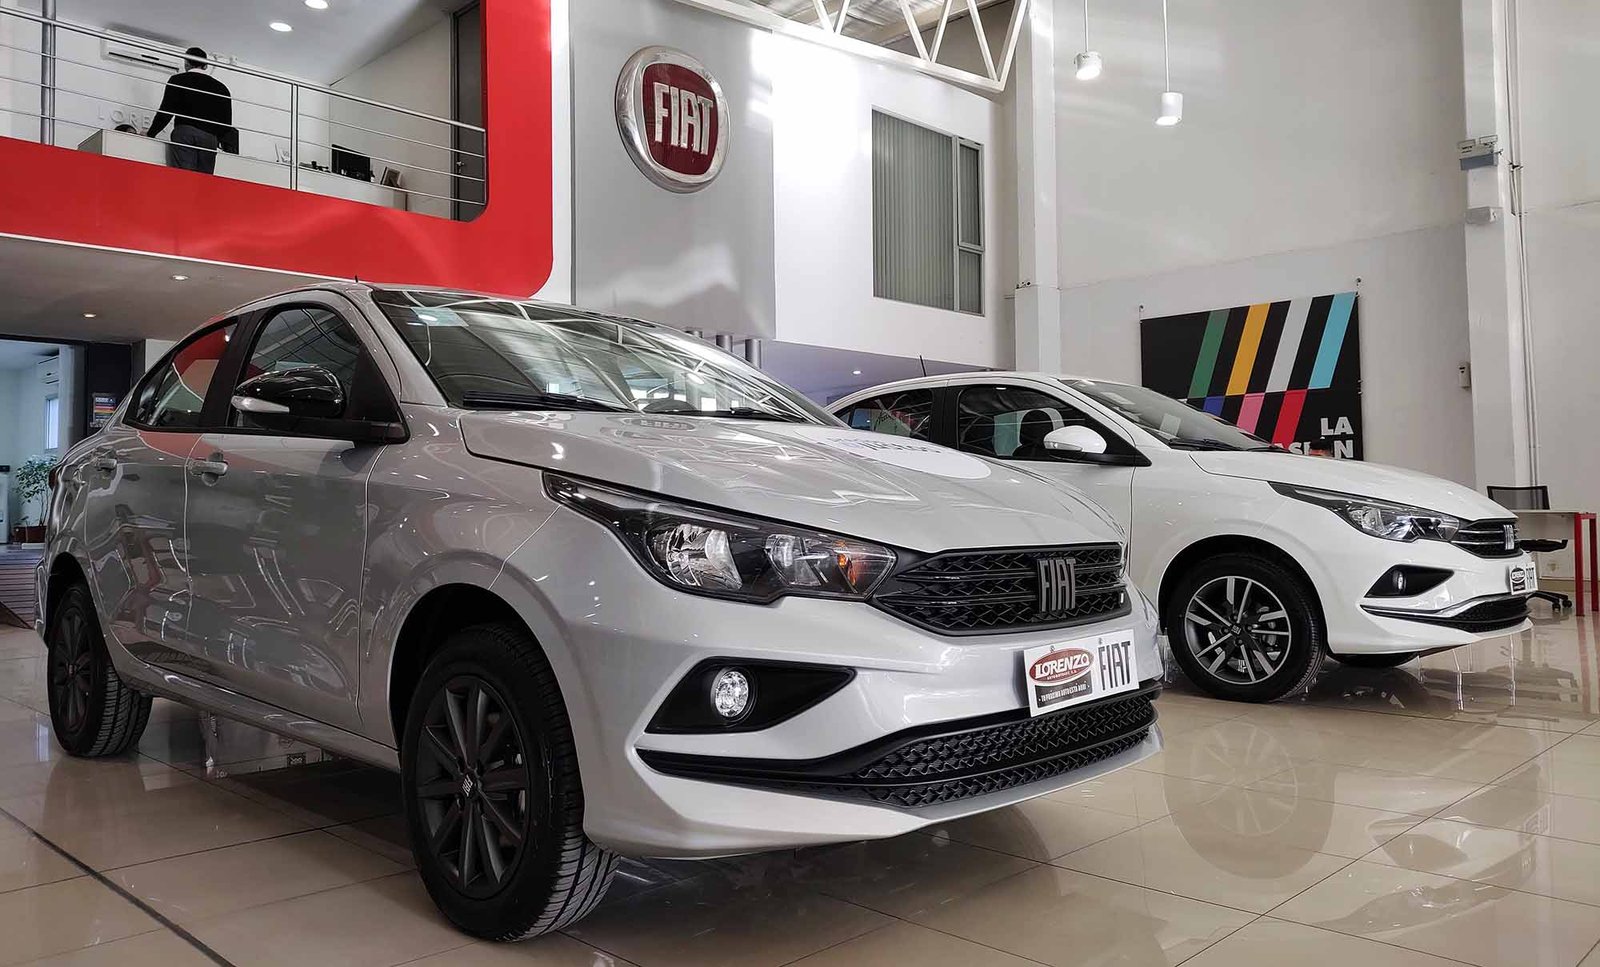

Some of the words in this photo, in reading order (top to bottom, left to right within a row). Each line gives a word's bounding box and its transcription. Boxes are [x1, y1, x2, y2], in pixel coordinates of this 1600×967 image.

[653, 81, 713, 155] FIAT
[1320, 416, 1354, 436] LA
[1039, 559, 1076, 612] FIAT
[1035, 653, 1090, 679] LORENZO
[1098, 641, 1131, 690] FIAT
